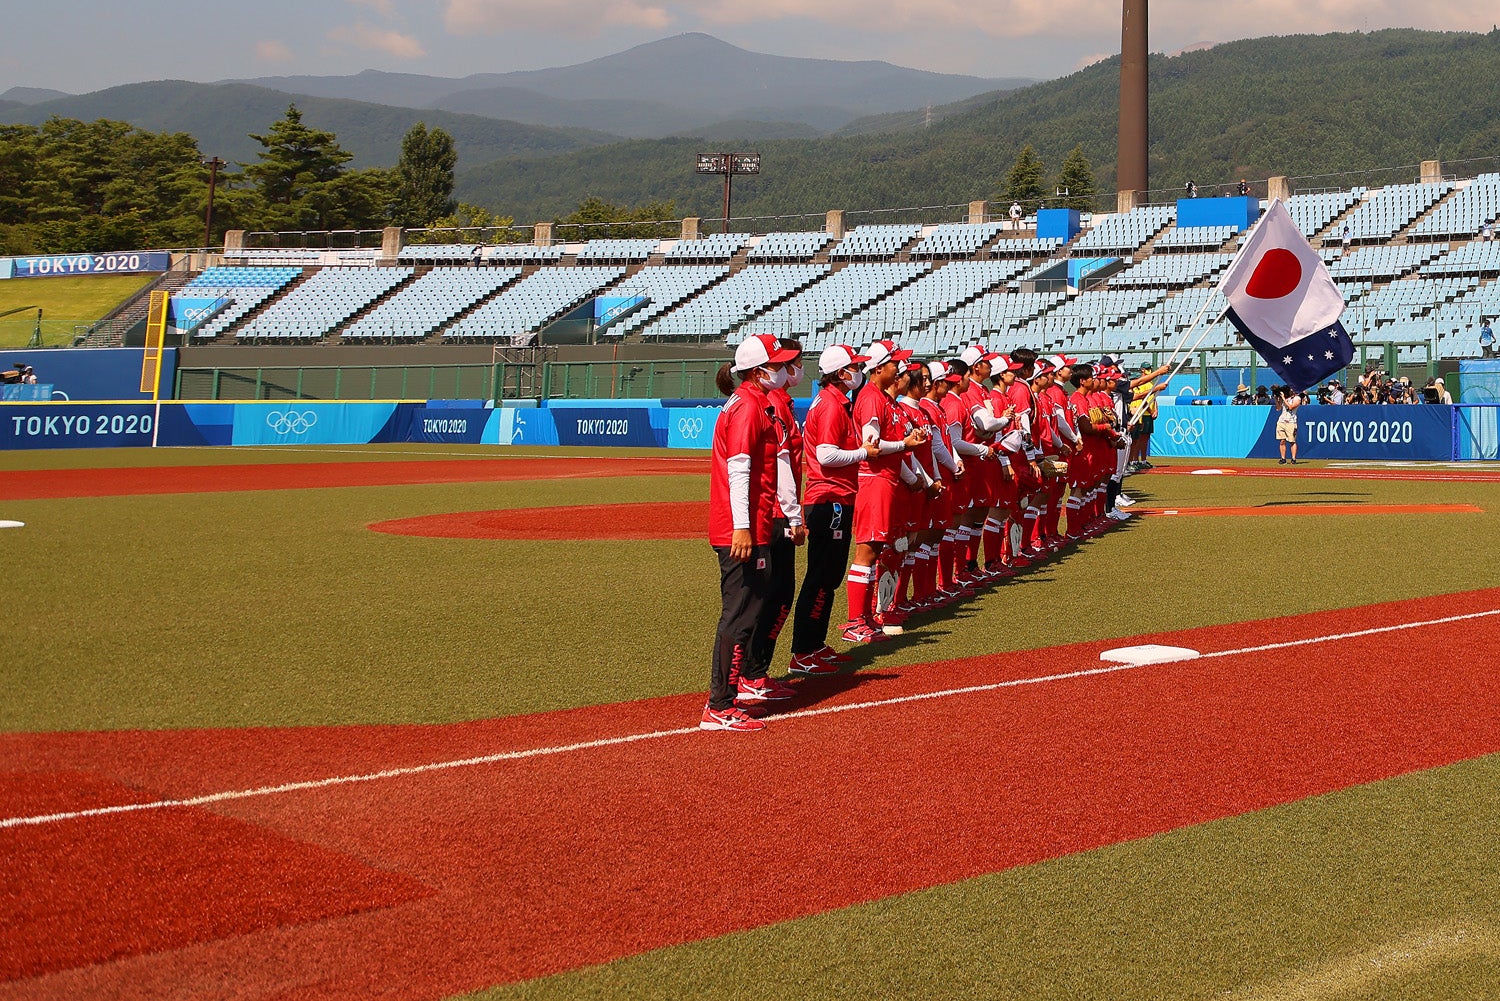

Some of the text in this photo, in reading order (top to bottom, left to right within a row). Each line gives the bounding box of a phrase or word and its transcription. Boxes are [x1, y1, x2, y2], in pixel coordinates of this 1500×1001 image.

[26, 254, 140, 274] TOKYO 2020
[12, 414, 152, 436] TOKYO 2020
[423, 418, 467, 433] TOKYO 2020
[576, 419, 628, 435] TOKYO 2020
[1305, 421, 1413, 443] TOKYO 2020
